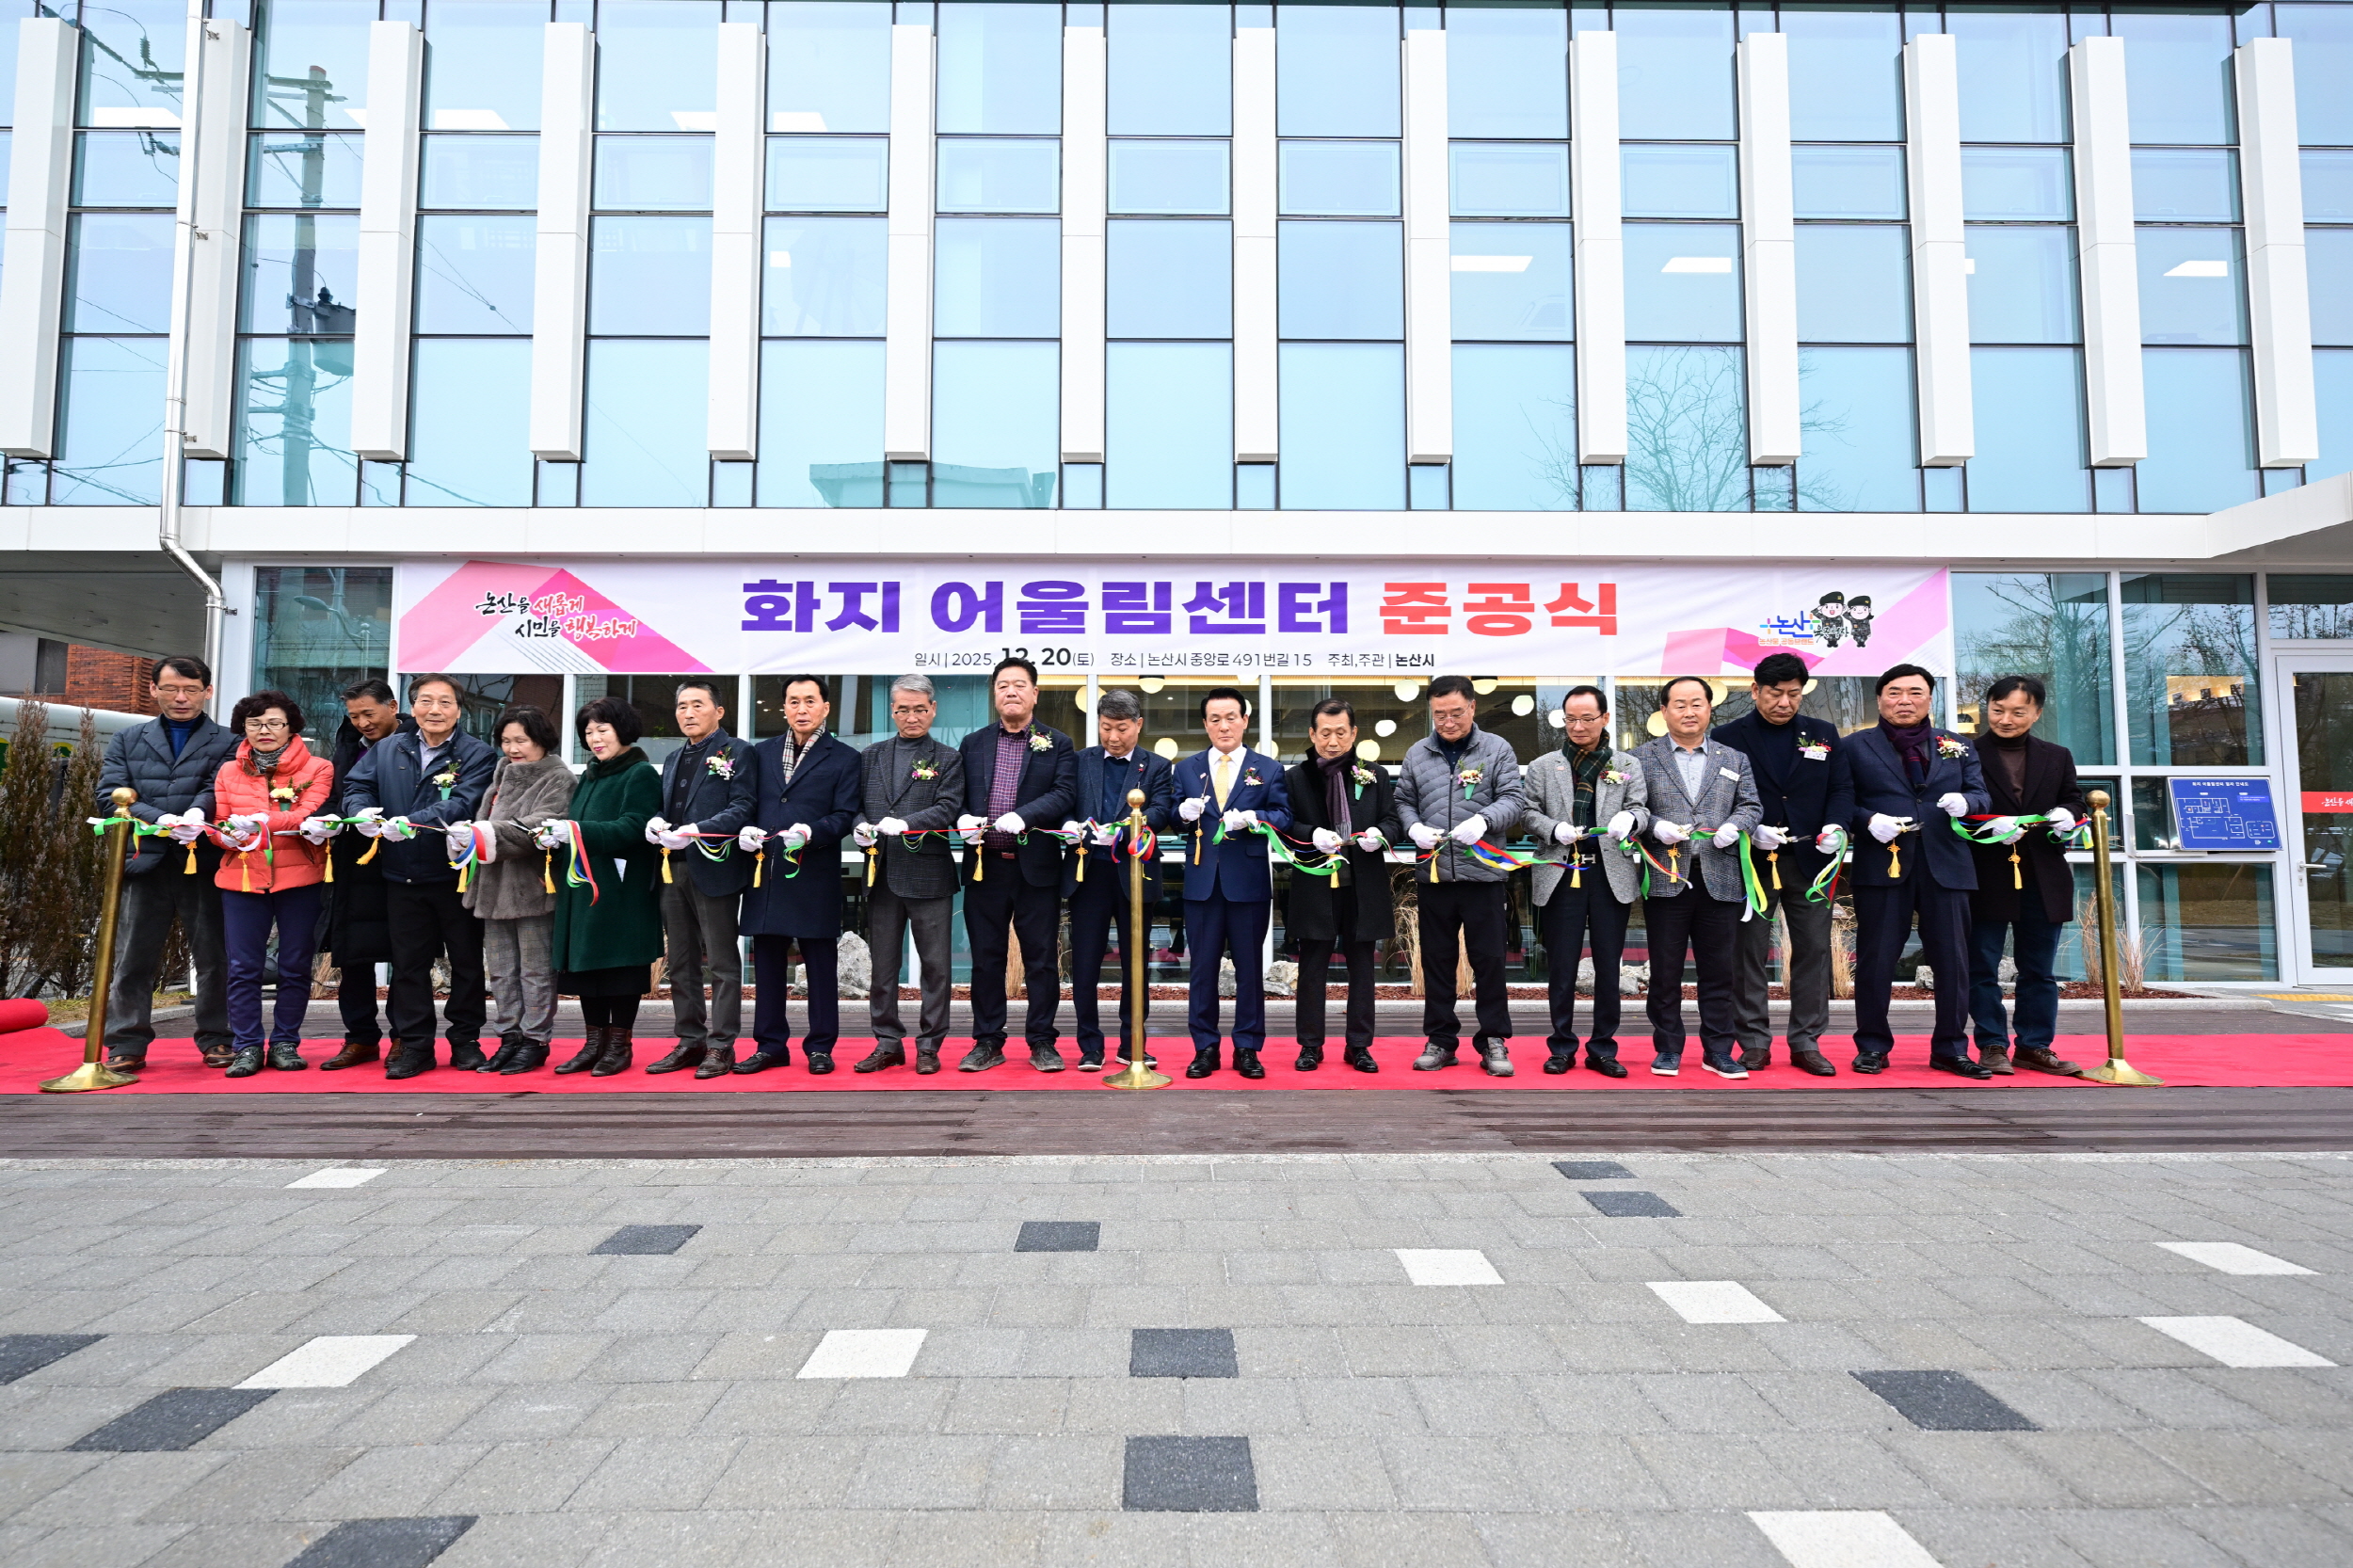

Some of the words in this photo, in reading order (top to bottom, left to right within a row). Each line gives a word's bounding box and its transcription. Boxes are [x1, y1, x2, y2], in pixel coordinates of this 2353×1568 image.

[475, 592, 531, 616] 논산을
[534, 594, 584, 616] 새롭게
[741, 579, 901, 633] 화지
[931, 581, 1348, 634] 어울림센터
[1379, 582, 1617, 637] 준공식
[515, 616, 561, 638] 시민을
[565, 615, 637, 641] 행복하게
[1769, 610, 1814, 638] 논산
[914, 652, 940, 666] 일시
[952, 652, 997, 666] 2025.
[1041, 647, 1095, 667] 20(토)
[1111, 652, 1137, 666] 장소
[1147, 652, 1187, 666] 논산시
[1294, 653, 1312, 666] 15
[1328, 653, 1385, 668] 주최,주관
[1395, 653, 1434, 667] 논산시
